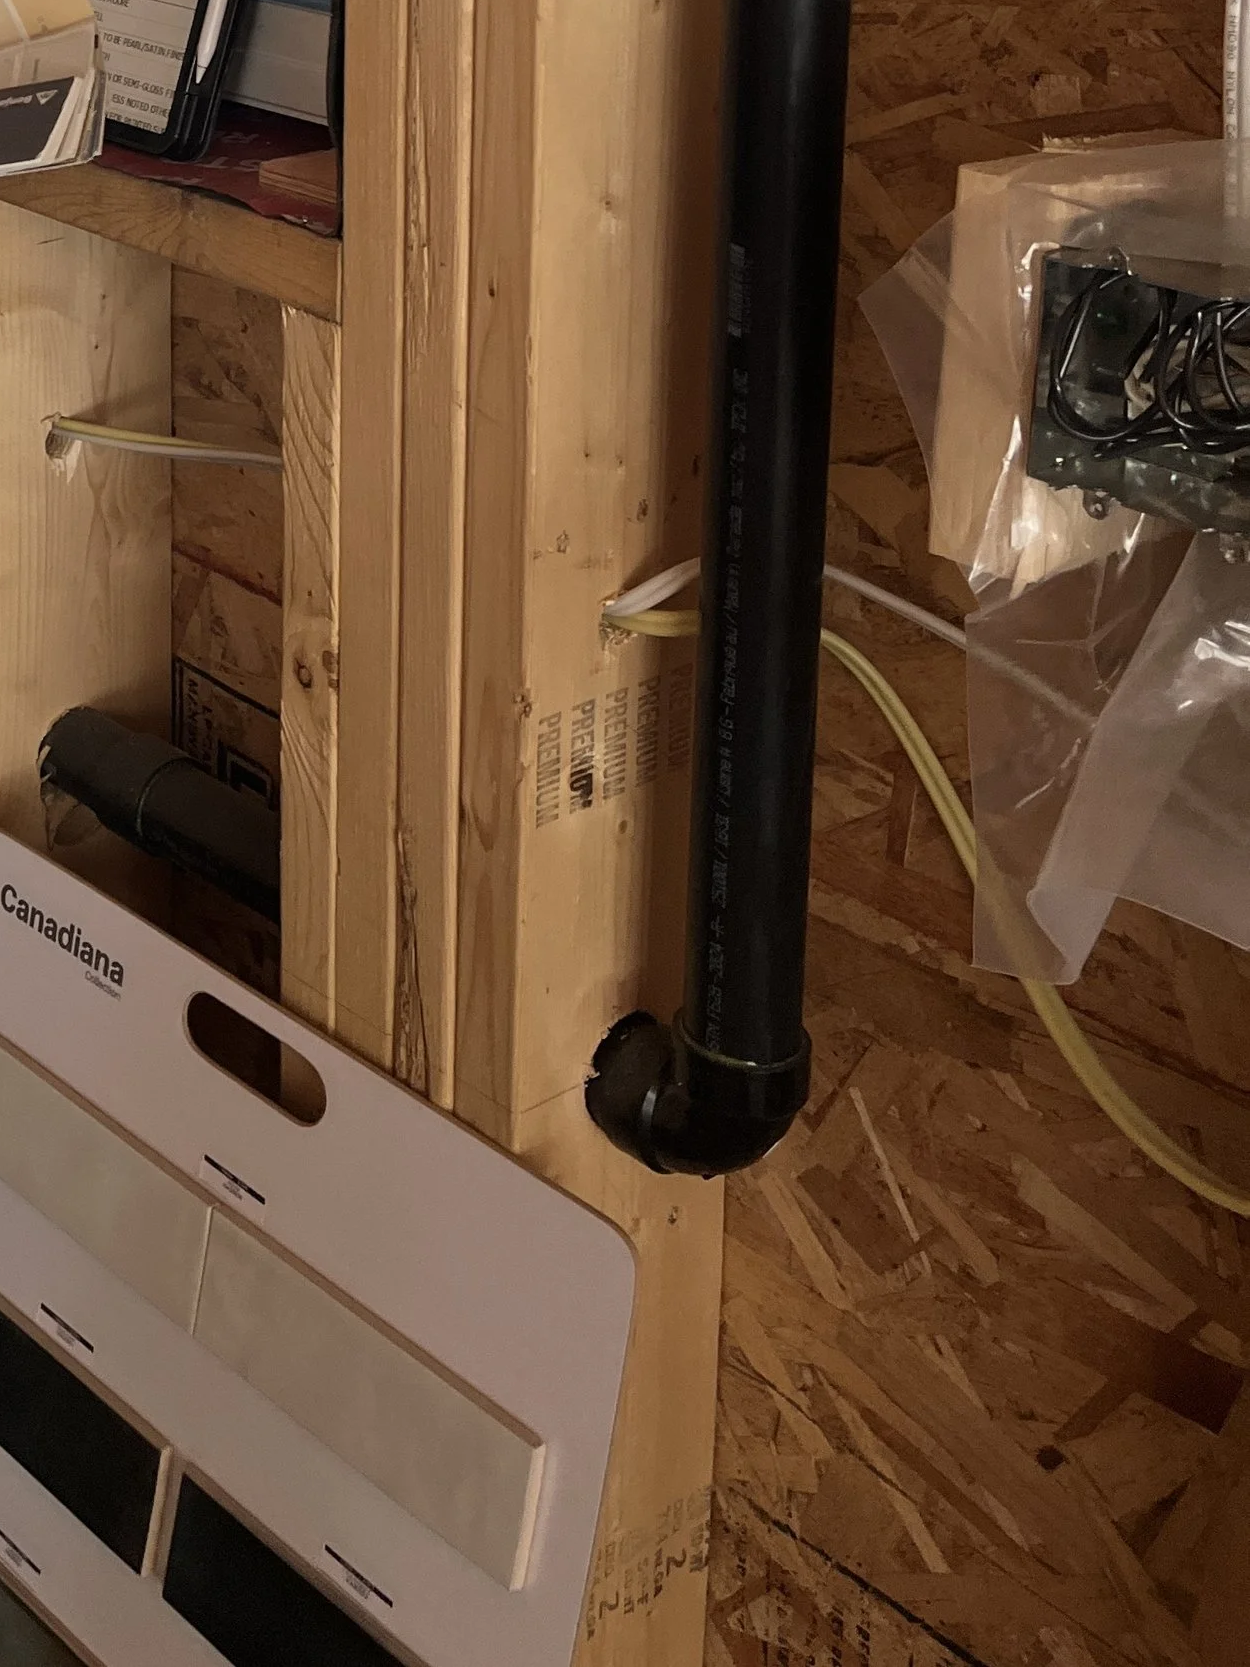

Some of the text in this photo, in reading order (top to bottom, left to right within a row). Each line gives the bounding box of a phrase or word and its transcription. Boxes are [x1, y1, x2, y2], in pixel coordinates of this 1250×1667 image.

[103, 33, 113, 43] TO
[127, 95, 149, 111] NOTED
[536, 711, 562, 829] PREMIUM
[602, 687, 629, 800] PREMIUM
[0, 883, 125, 987] Canadiana
